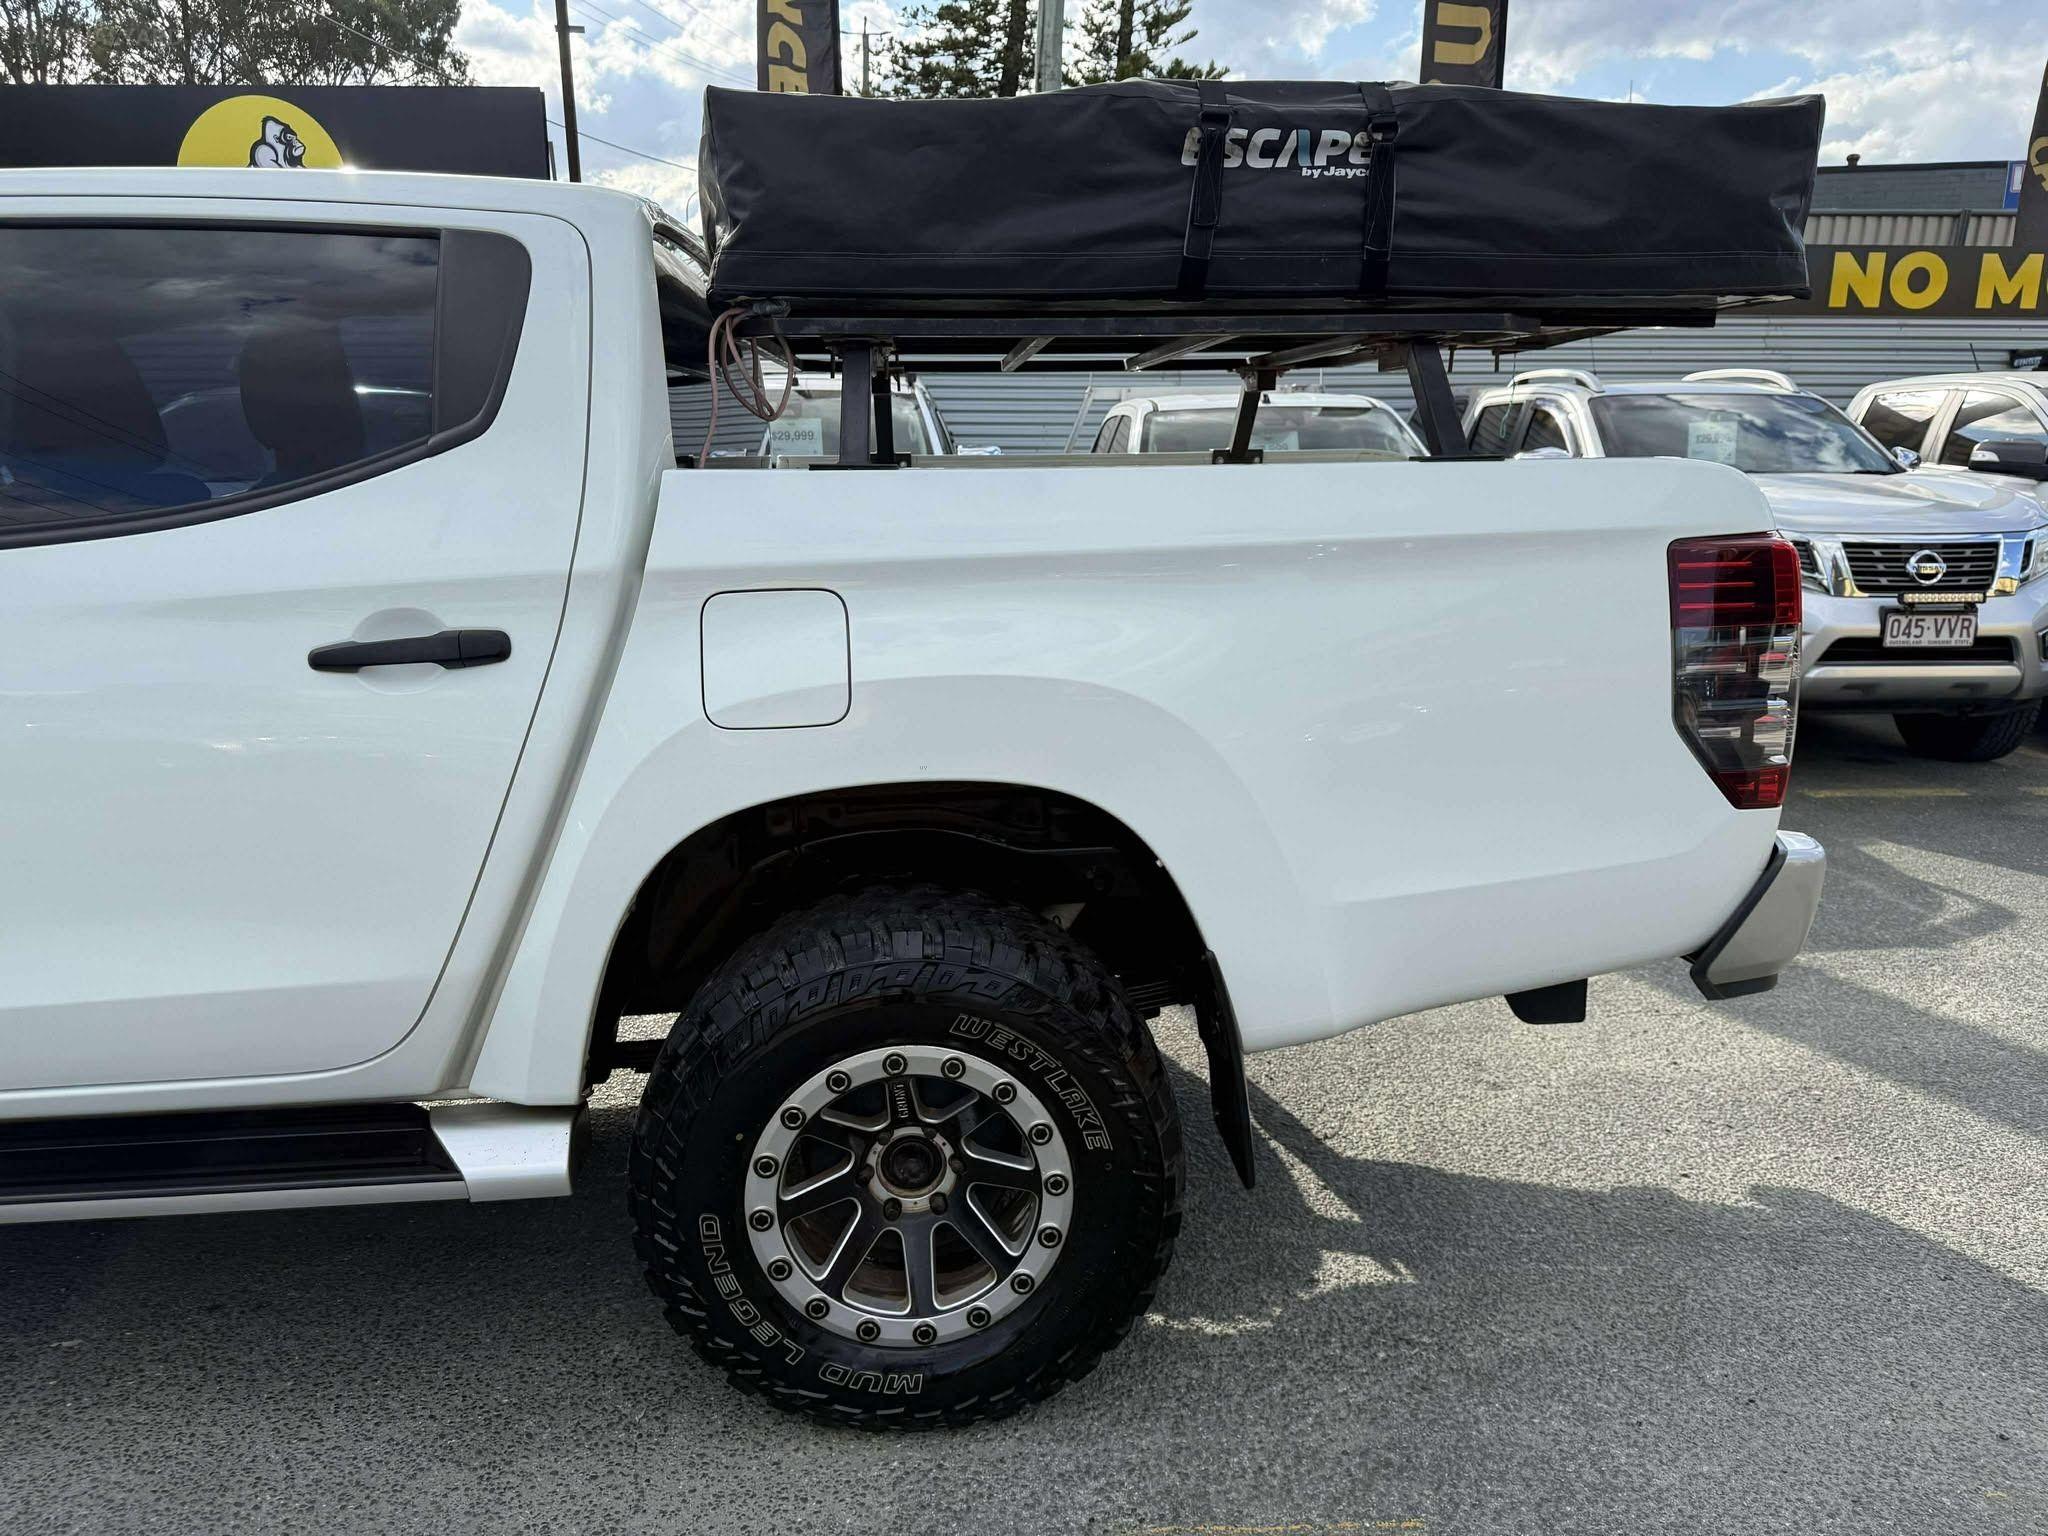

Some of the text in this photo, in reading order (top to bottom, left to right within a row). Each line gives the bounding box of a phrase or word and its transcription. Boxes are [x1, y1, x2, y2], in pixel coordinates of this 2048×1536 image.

[1301, 166, 1370, 179] by Jayc
[1828, 251, 2048, 309] NO M
[949, 1013, 1110, 1150] WESTLAKE
[699, 1213, 805, 1365] LEGEND
[818, 1362, 923, 1395] MUD
